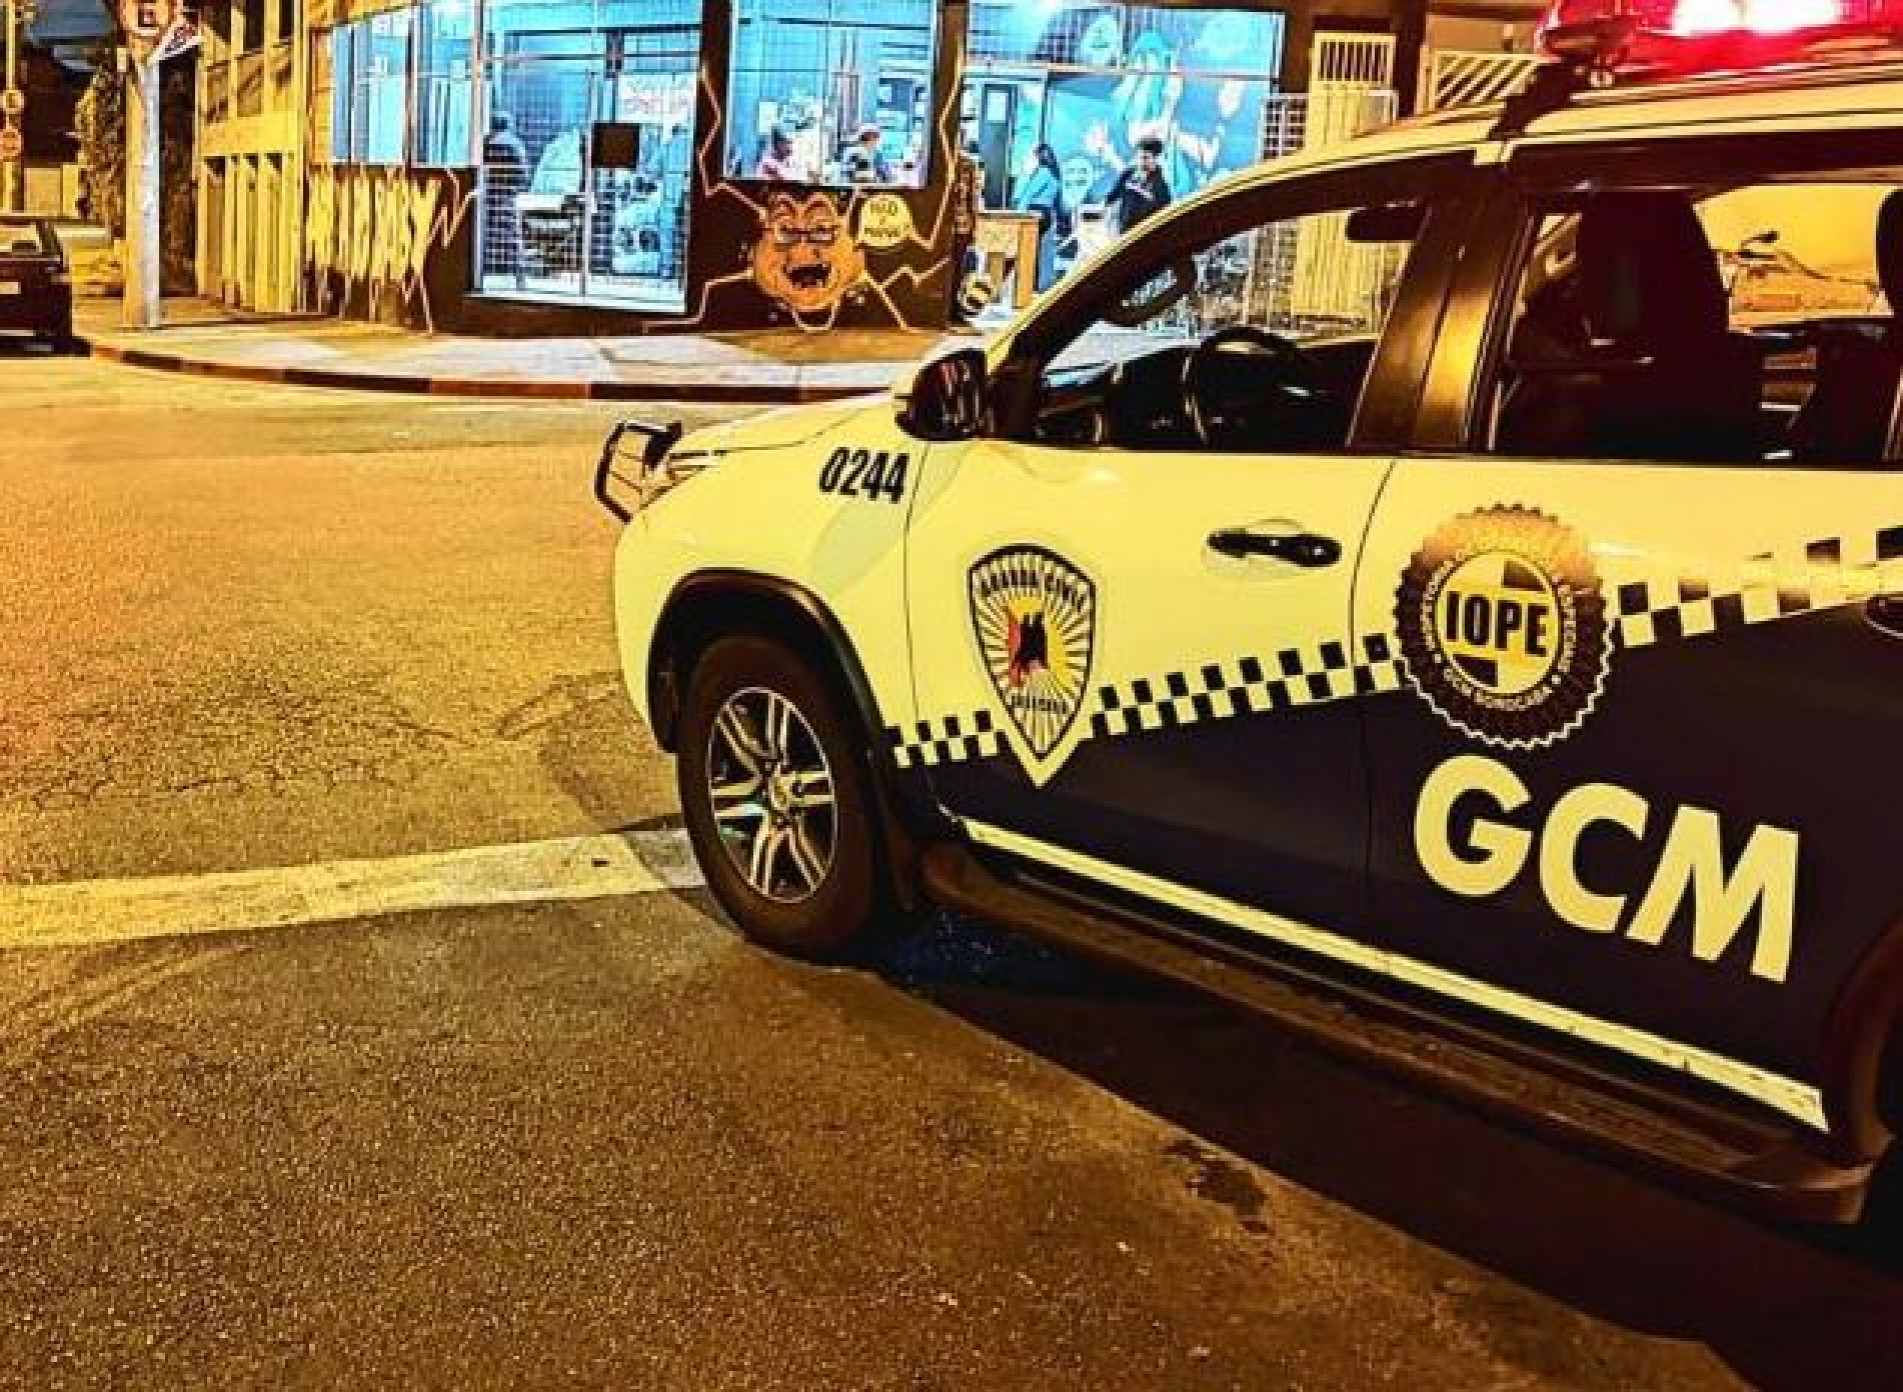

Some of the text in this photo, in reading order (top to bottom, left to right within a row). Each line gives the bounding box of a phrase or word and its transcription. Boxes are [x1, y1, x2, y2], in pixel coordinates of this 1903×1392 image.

[819, 447, 909, 504] 0244
[1446, 590, 1549, 657] IOPE
[1415, 755, 1799, 983] GCM
